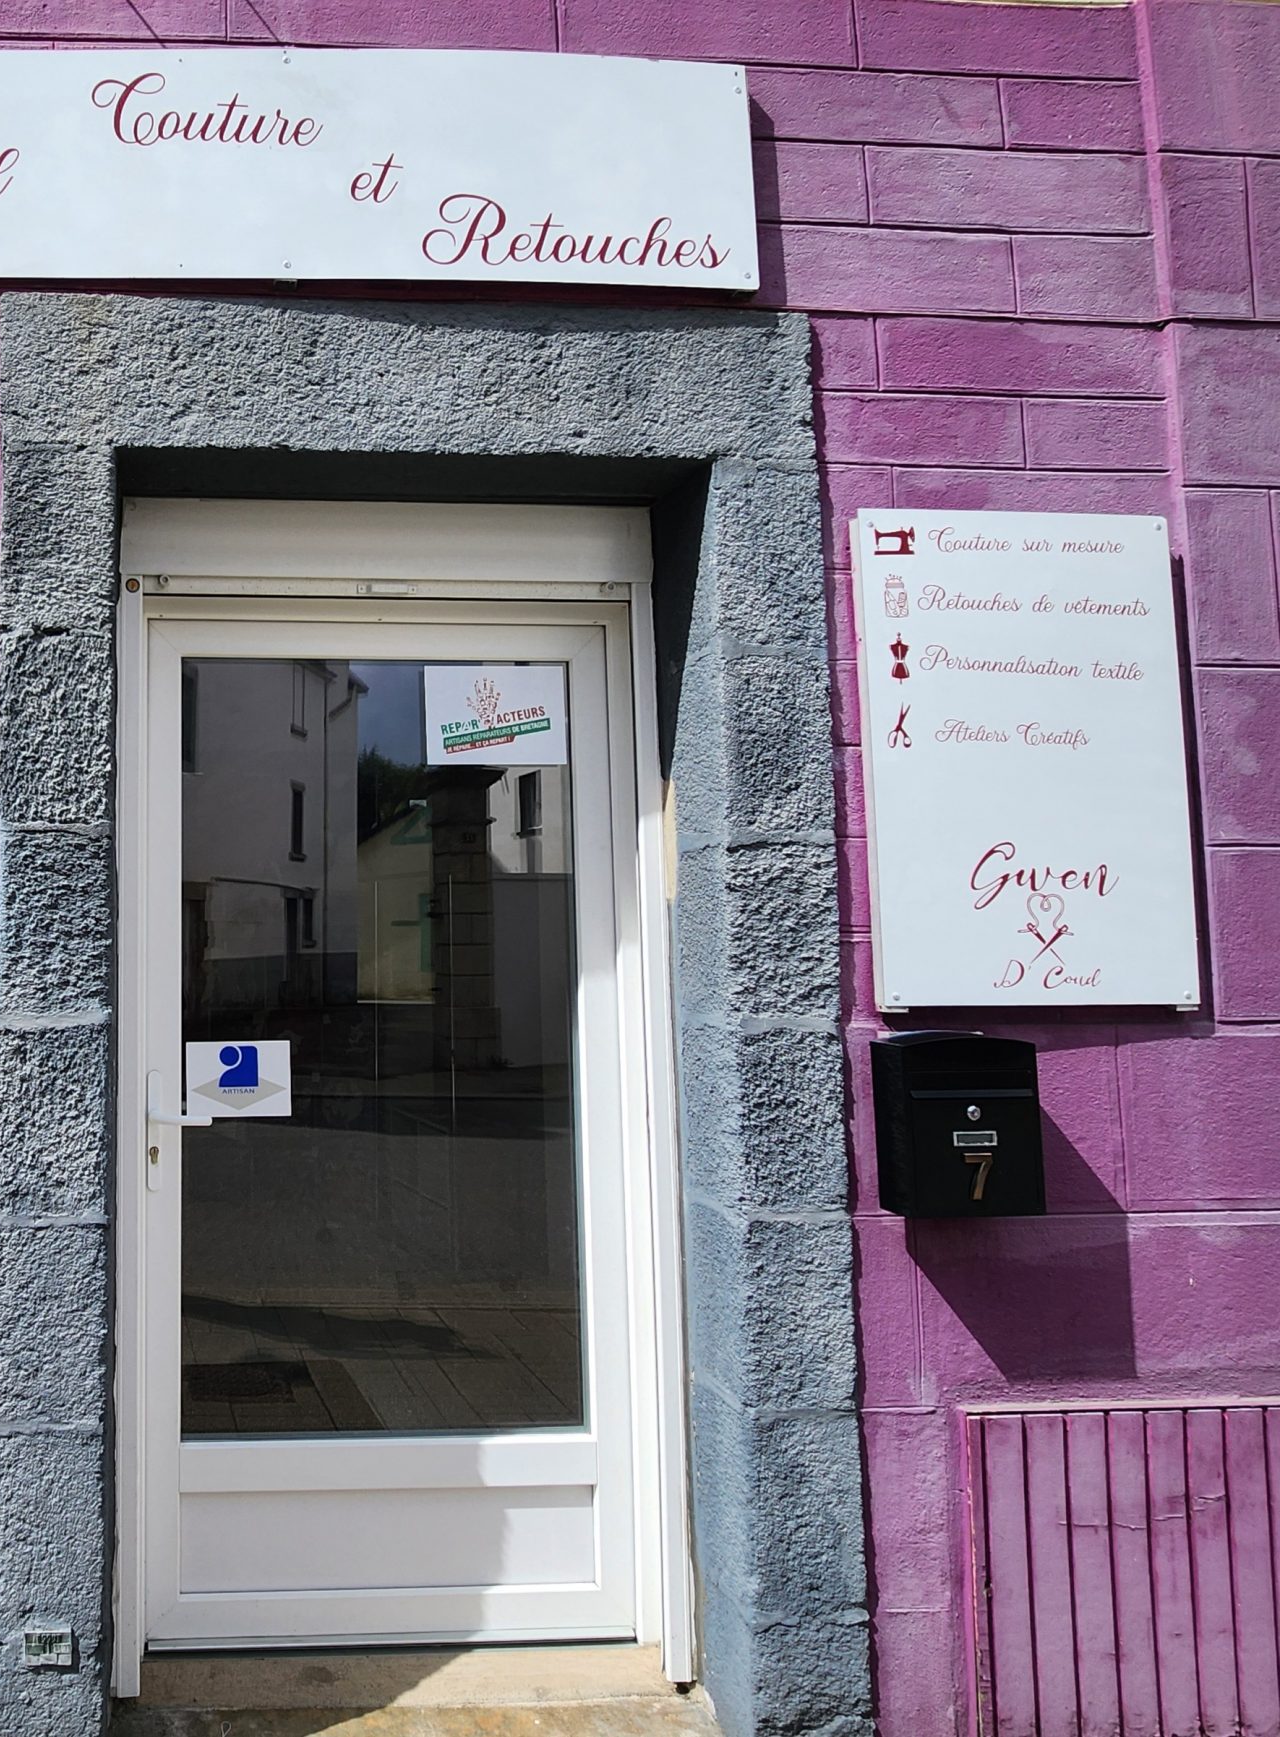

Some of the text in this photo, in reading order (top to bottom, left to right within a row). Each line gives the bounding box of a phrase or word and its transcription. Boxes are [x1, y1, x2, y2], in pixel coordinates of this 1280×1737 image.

[91, 72, 324, 147] Couture
[350, 152, 404, 204] et
[421, 193, 731, 269] Retouches
[927, 526, 1125, 554] Couture sur mesure
[917, 584, 1023, 613] Retouches
[1031, 593, 1055, 613] de
[919, 644, 1145, 681] Personnalisation textile
[496, 706, 546, 725] ACTEURS
[934, 718, 1091, 751] Ateliers Créatifs
[970, 841, 1120, 910] Gwen
[1043, 965, 1102, 989] Coud
[964, 1153, 993, 1201] 7
